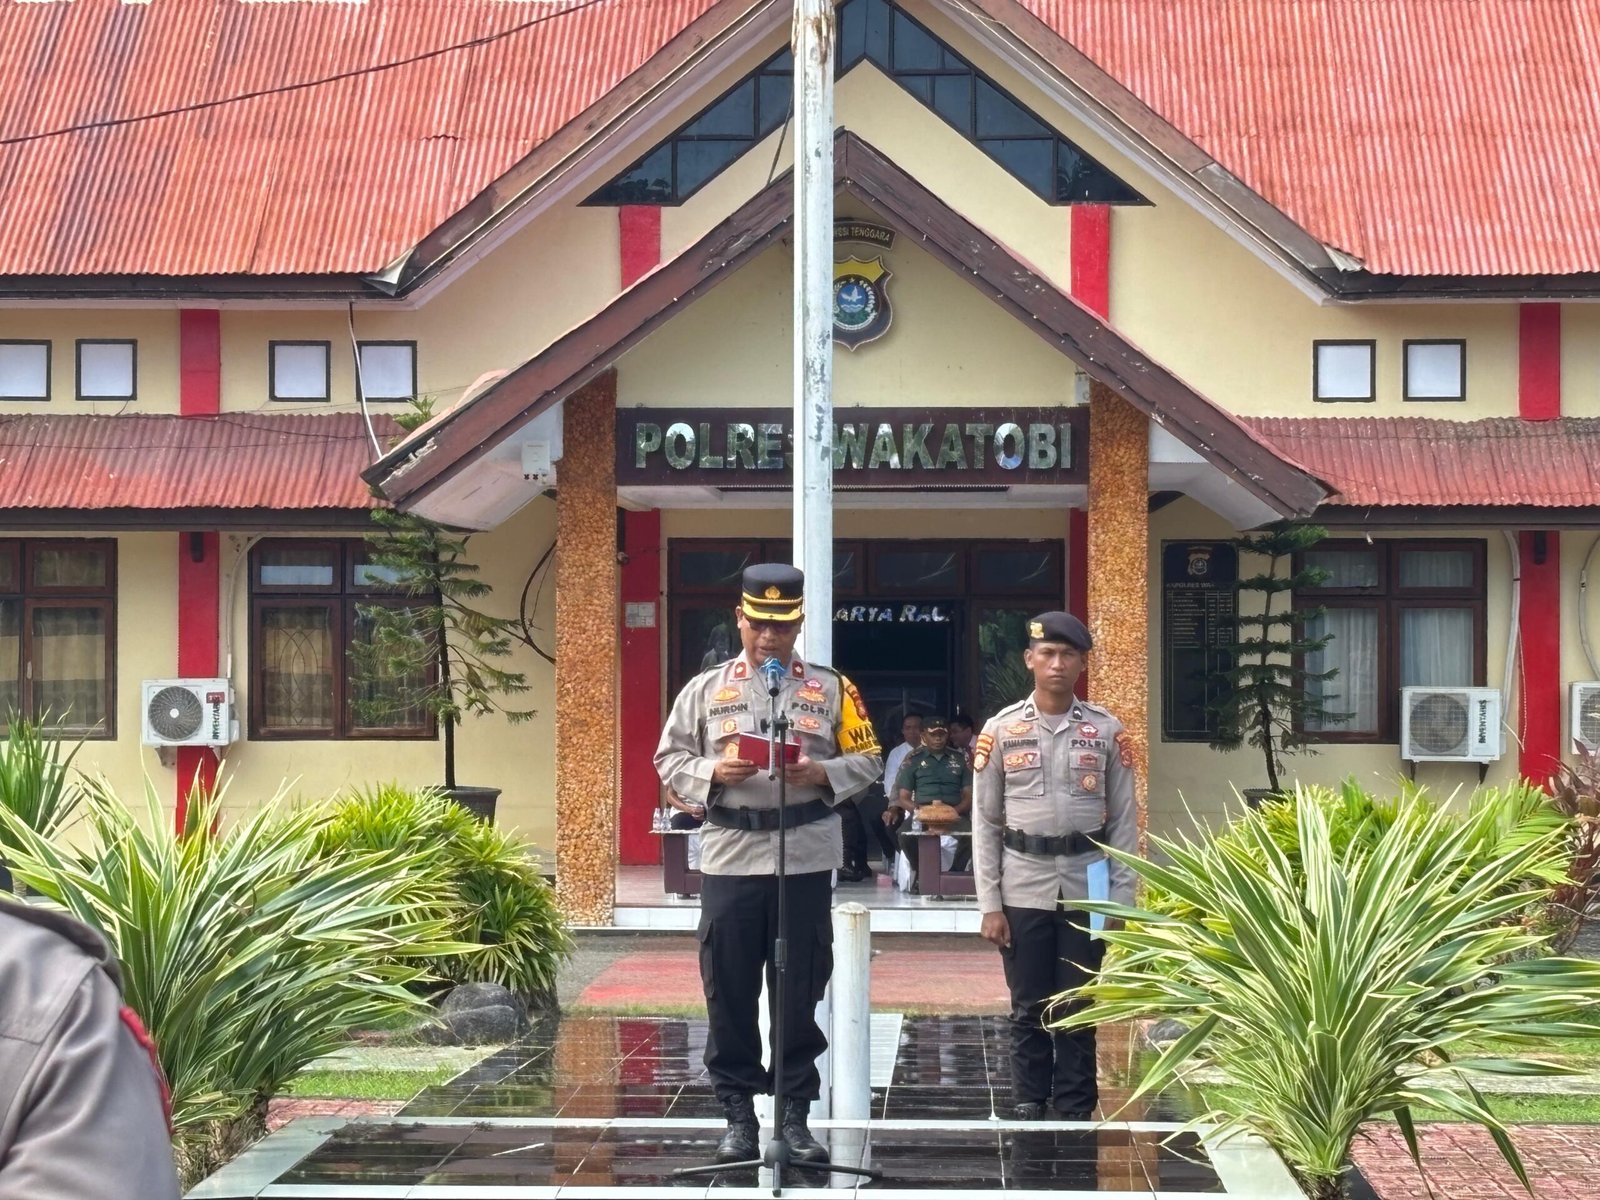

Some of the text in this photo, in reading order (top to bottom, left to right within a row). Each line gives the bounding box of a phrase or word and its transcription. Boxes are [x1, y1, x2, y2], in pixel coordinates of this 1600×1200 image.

[851, 226, 890, 242] TENGGARA
[832, 421, 1072, 470] WAKATOBI
[709, 703, 748, 717] NURDIN
[791, 702, 831, 716] POLRI
[1071, 739, 1107, 748] POLRI
